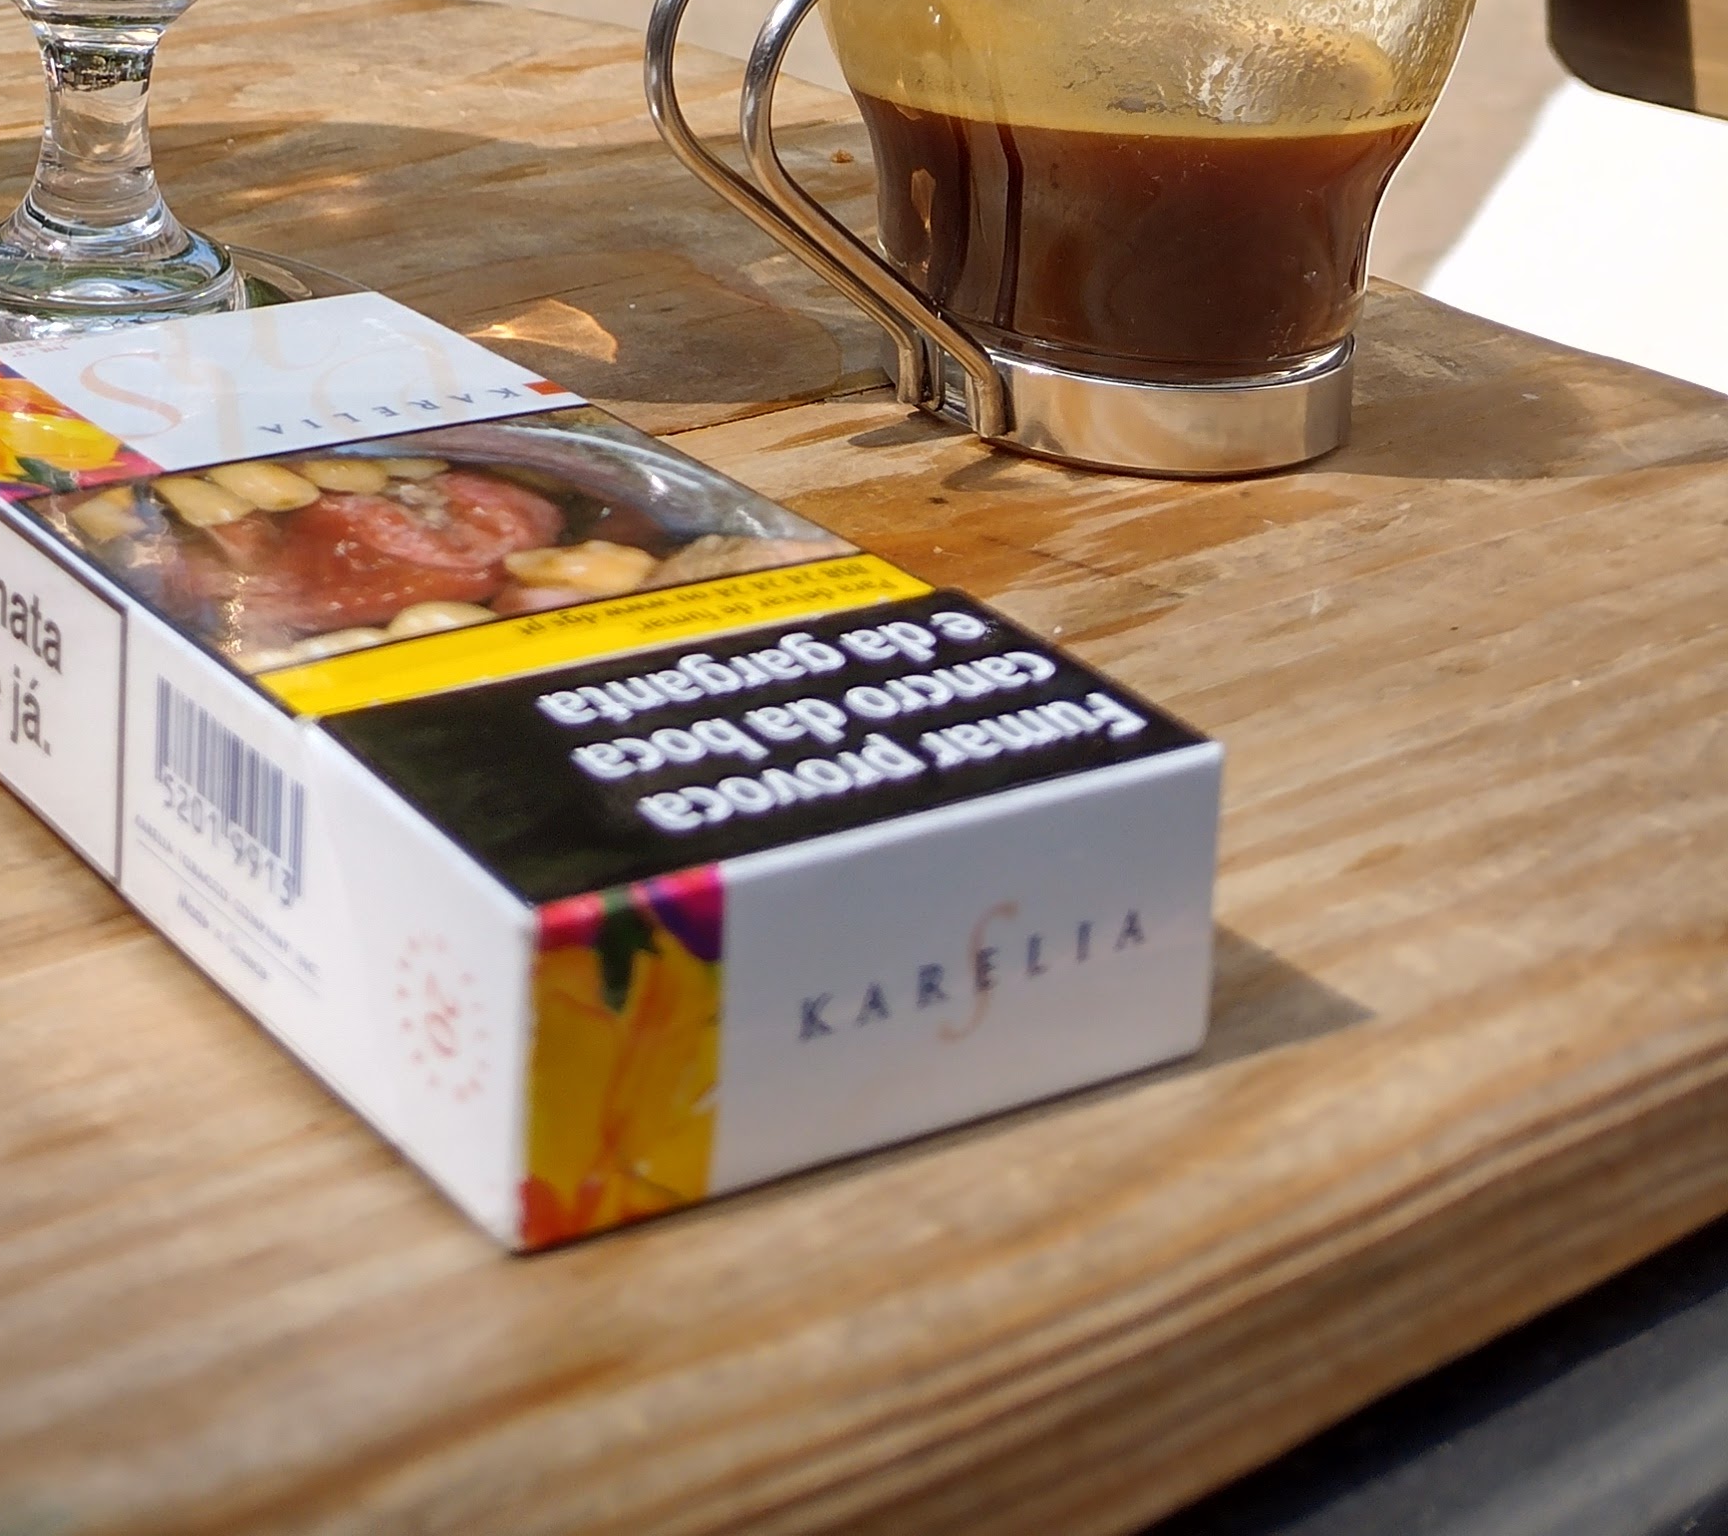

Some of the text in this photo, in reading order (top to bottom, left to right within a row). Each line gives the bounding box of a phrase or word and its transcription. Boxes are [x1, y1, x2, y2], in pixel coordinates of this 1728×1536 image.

[257, 386, 522, 436] KARELIA
[10, 664, 53, 757] já.
[534, 610, 991, 726] e da garganta
[572, 650, 1058, 781] cancro da boca
[635, 691, 1149, 832] Fumar provoca
[797, 906, 1149, 1042] KARELIA
